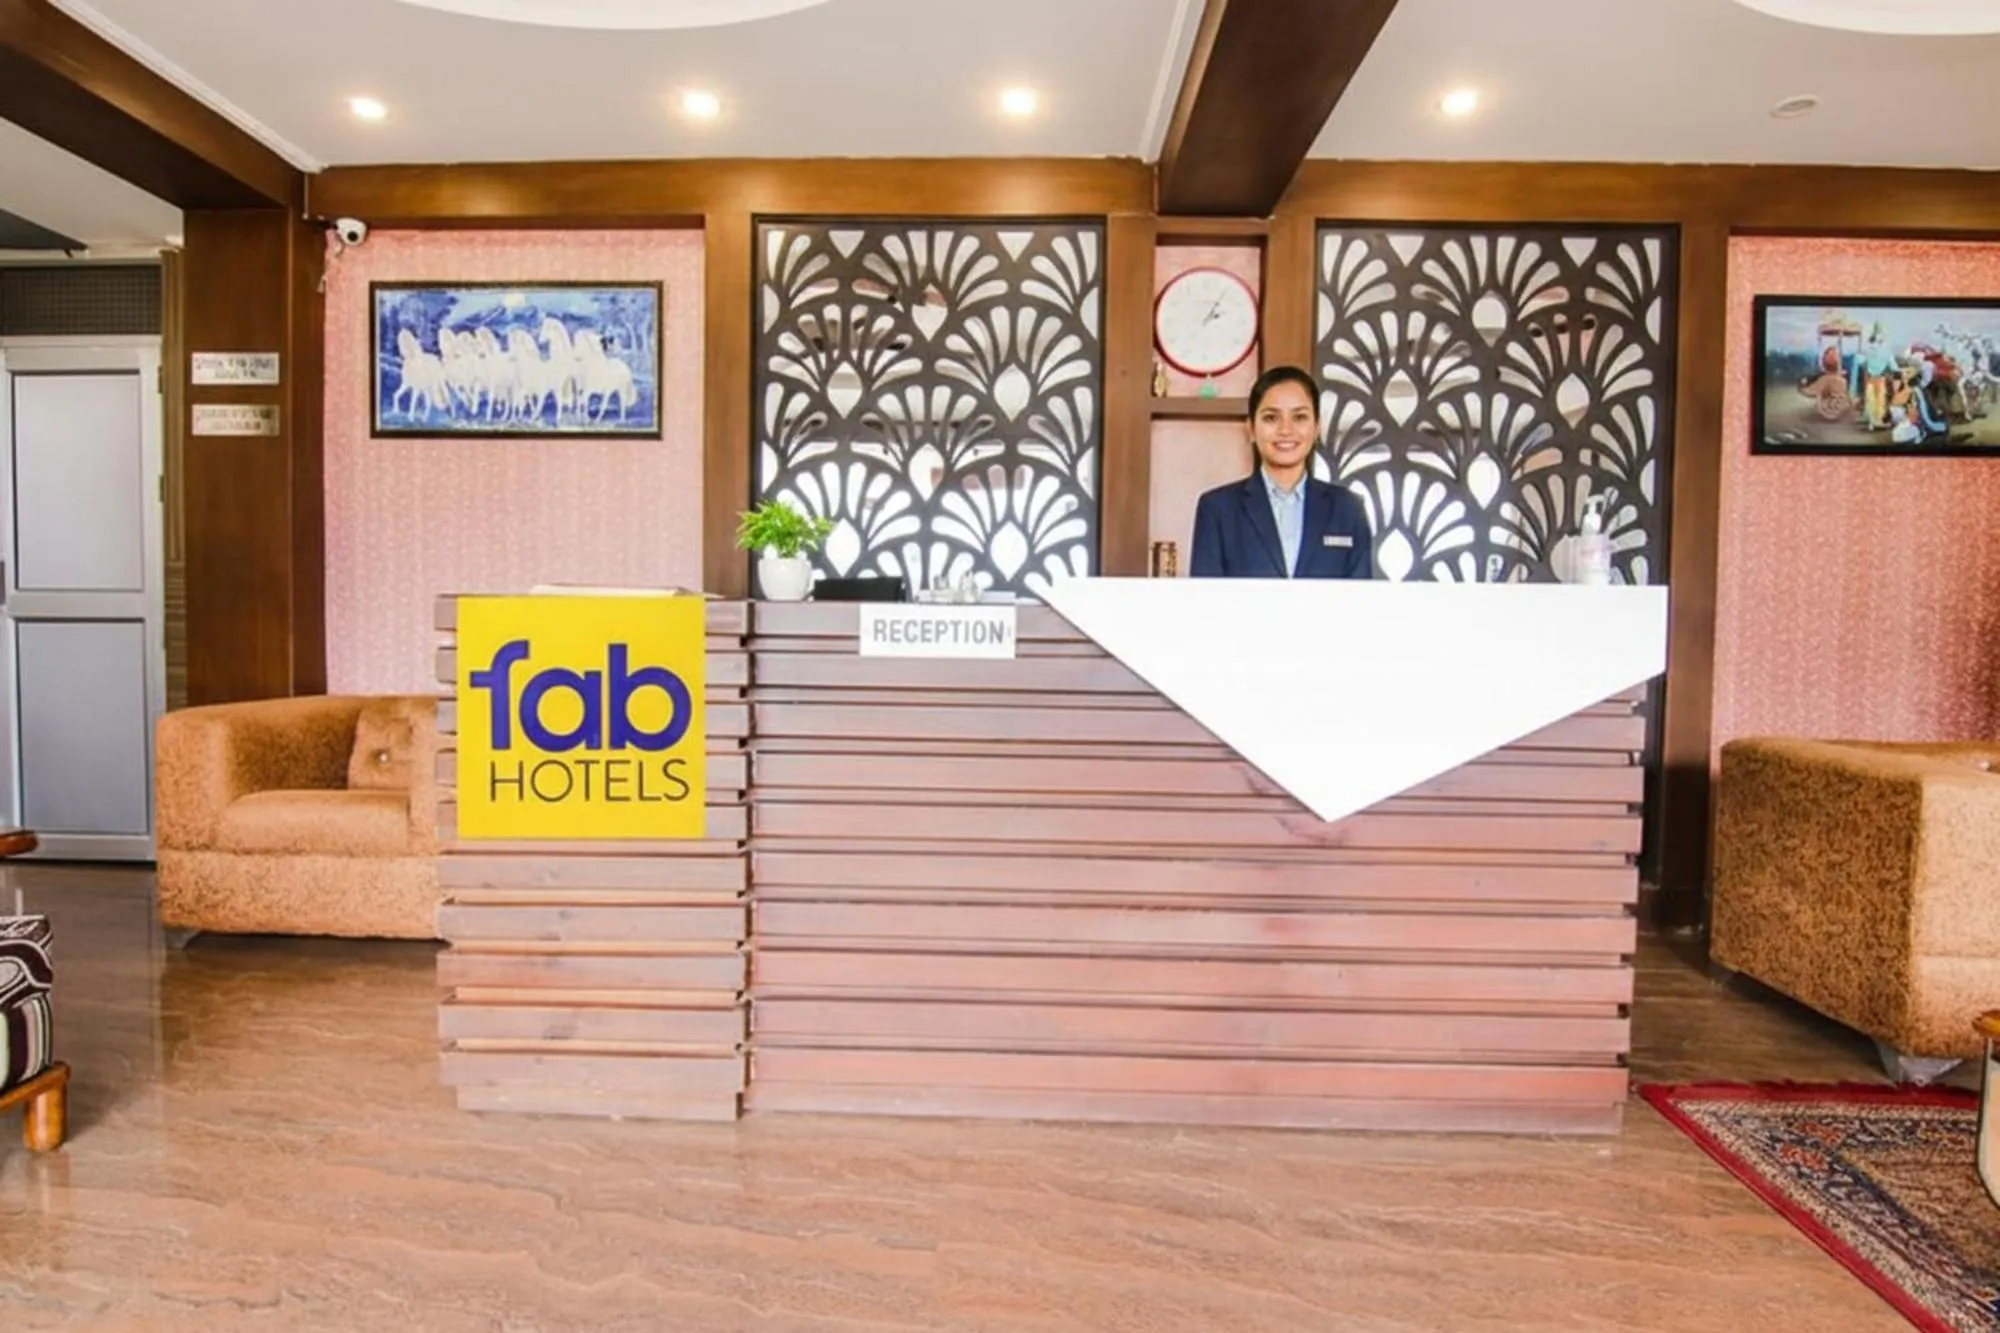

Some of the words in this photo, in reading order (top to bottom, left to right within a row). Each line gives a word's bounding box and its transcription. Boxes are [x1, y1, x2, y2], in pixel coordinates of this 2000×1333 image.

[873, 618, 1004, 644] RECEPTION
[468, 639, 692, 752] fab
[489, 758, 690, 802] HOTELS
